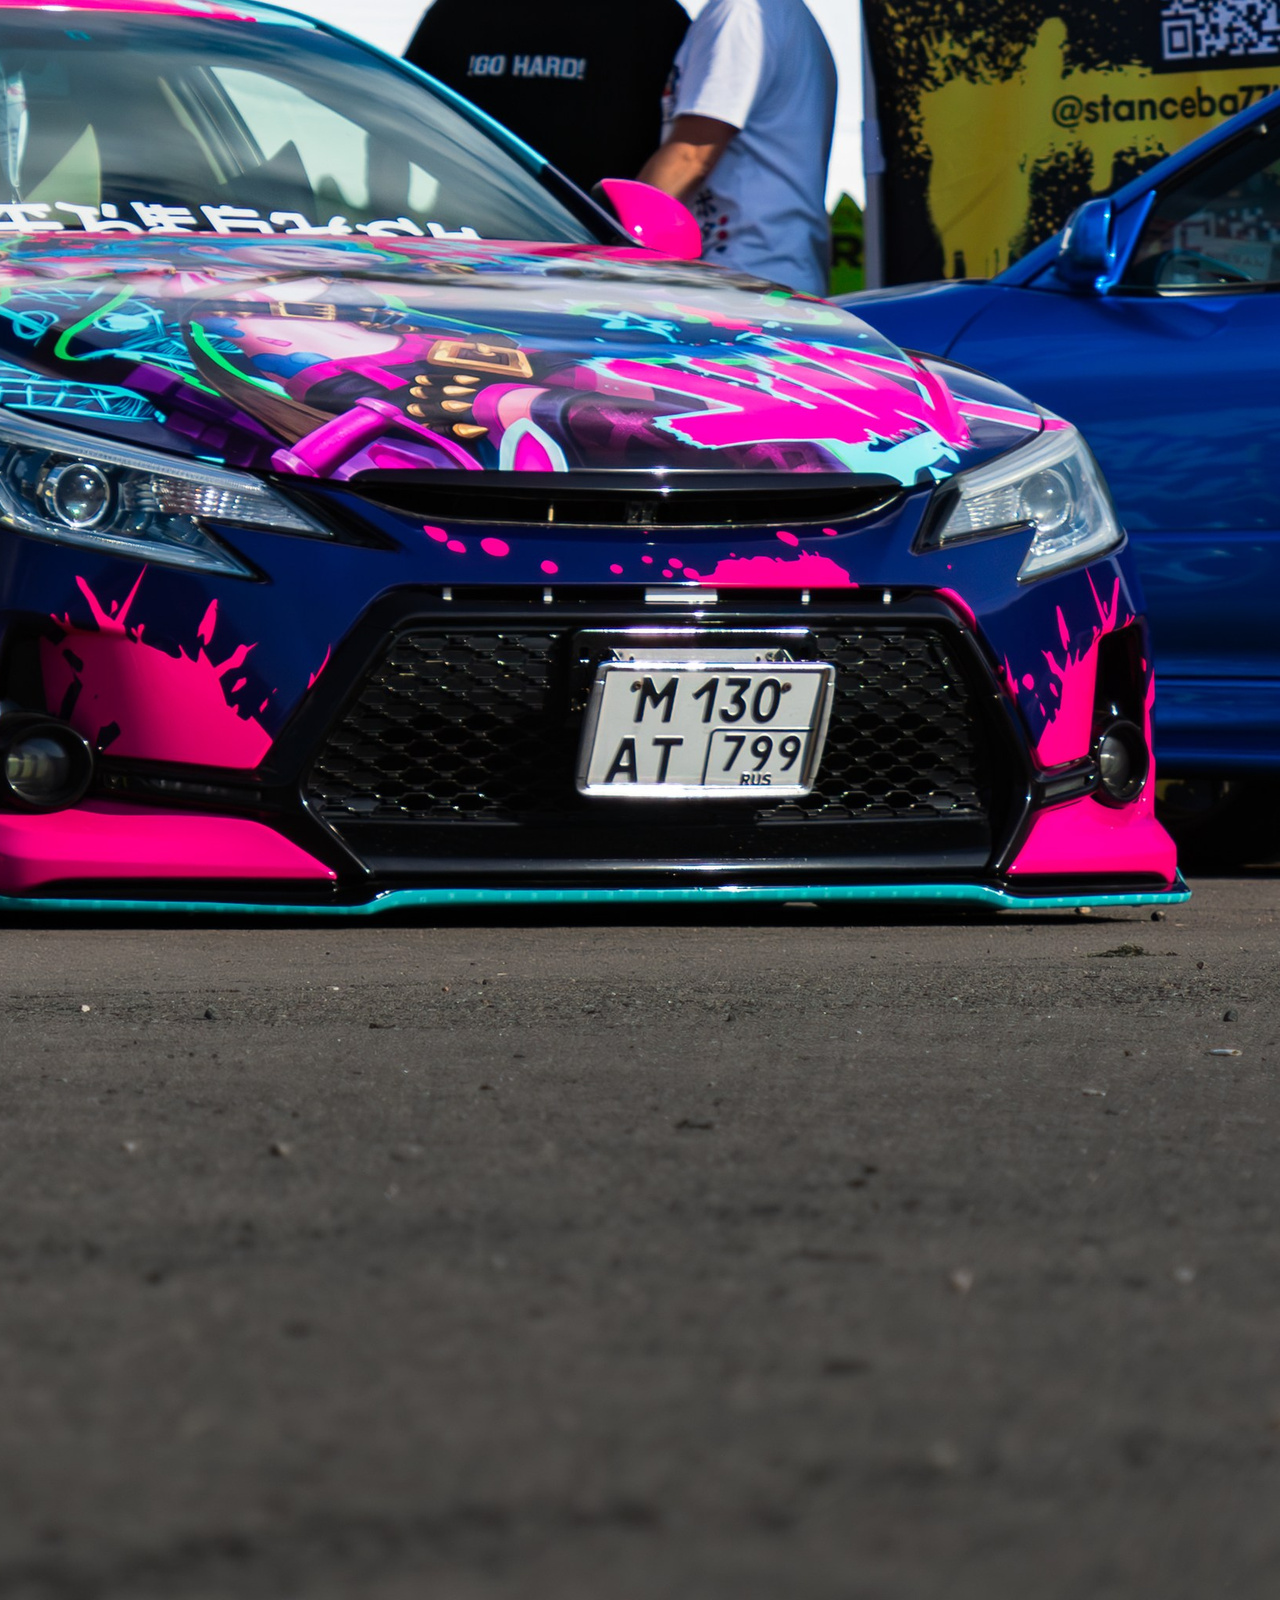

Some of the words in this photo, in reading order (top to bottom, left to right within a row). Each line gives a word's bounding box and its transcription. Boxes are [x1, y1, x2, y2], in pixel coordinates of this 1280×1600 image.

[512, 55, 586, 81] HARD!
[604, 735, 685, 784] AT
[722, 734, 802, 772] 799
[740, 771, 772, 785] RUS
